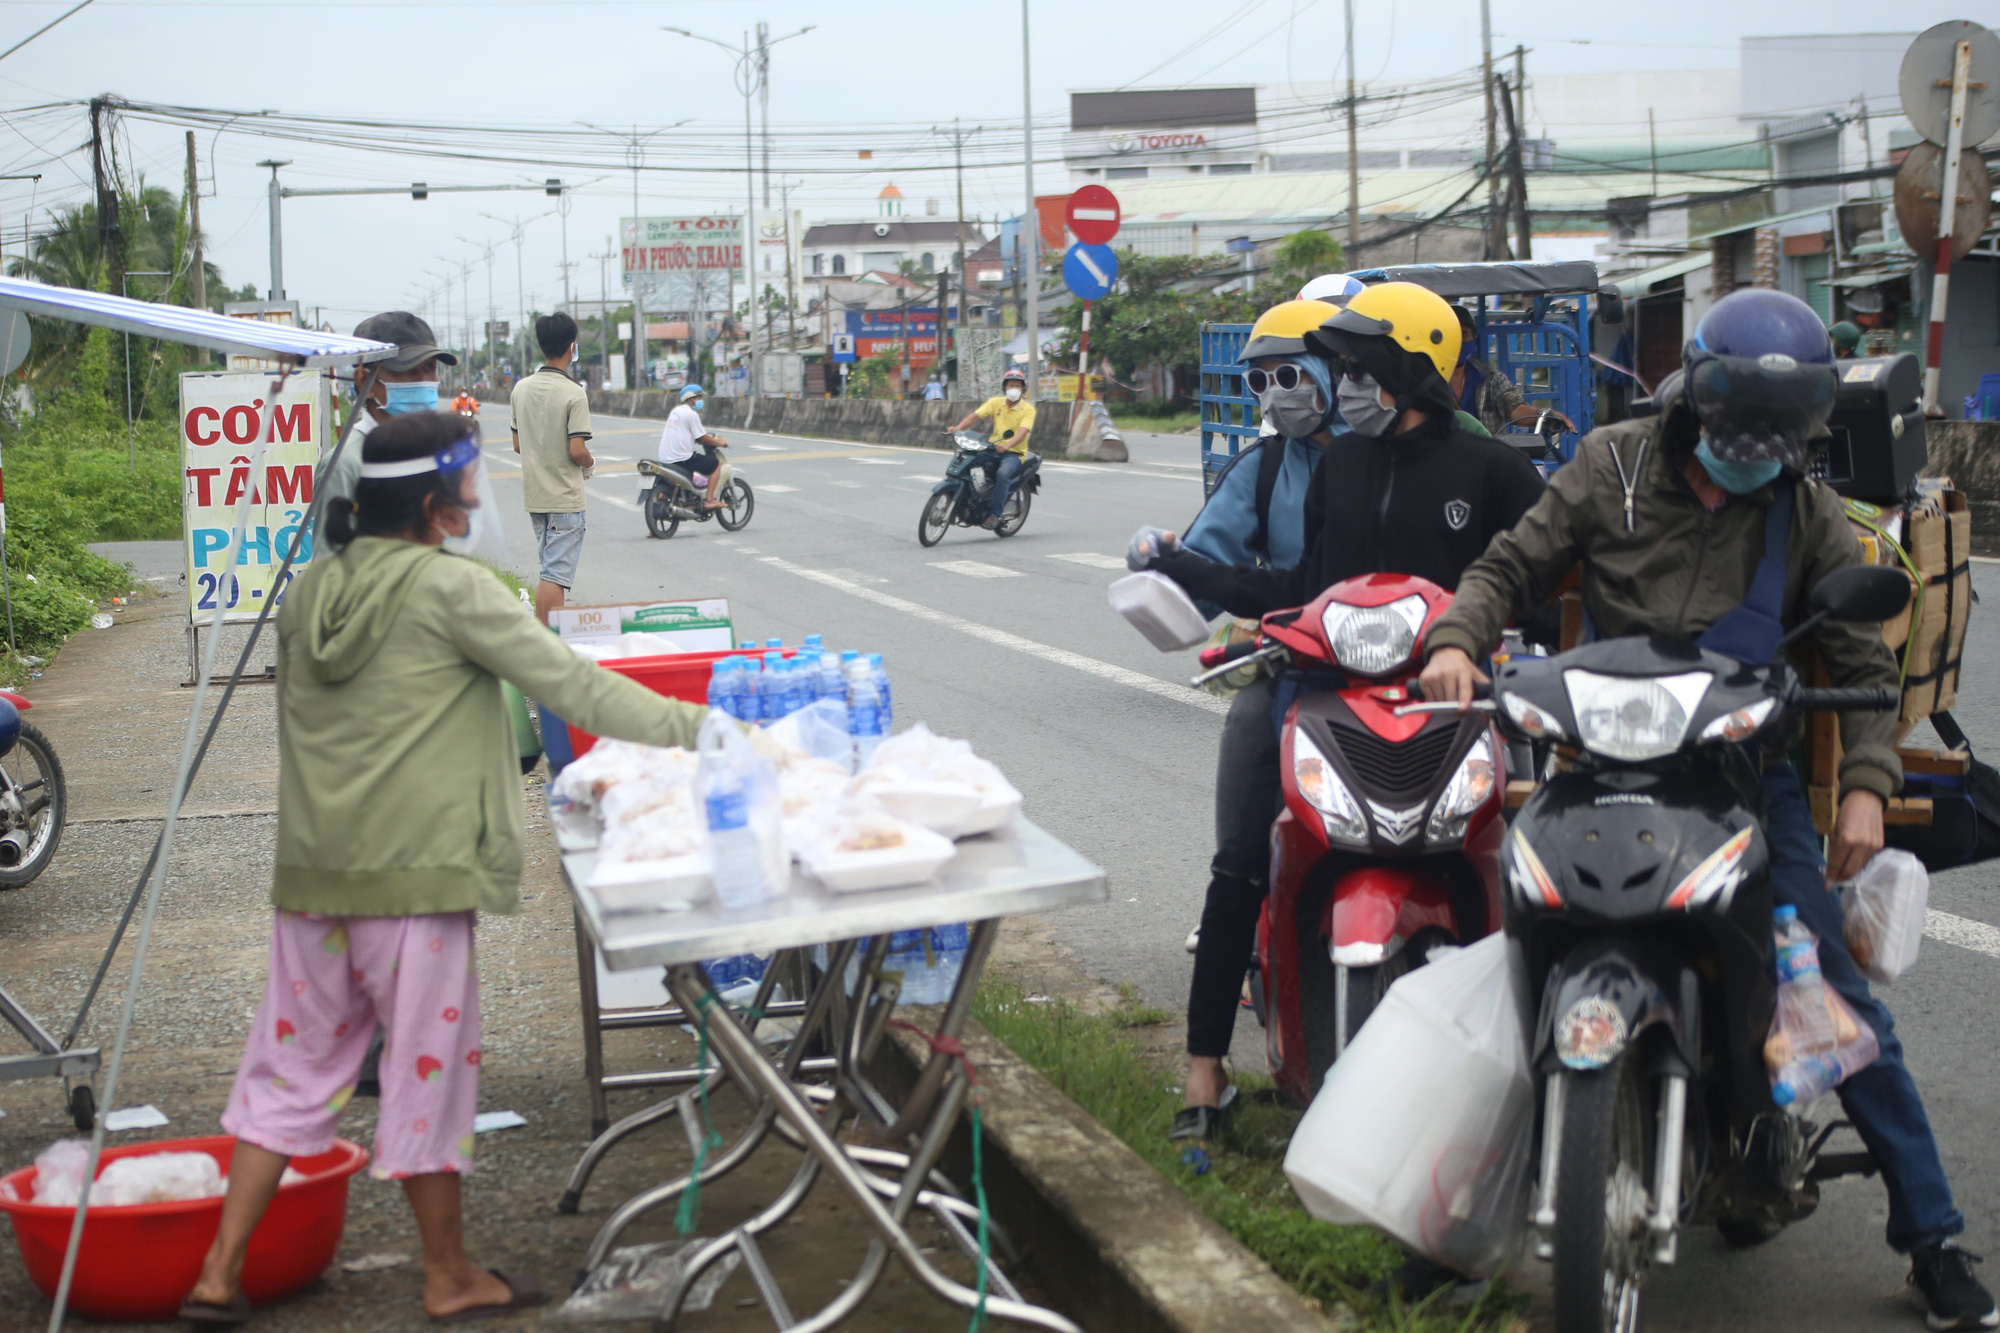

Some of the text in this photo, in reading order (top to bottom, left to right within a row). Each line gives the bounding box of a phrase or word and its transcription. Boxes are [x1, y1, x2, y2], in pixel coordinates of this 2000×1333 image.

[1137, 134, 1207, 149] TOYOTA
[184, 398, 311, 446] CƠM
[192, 509, 314, 568] PHỞ
[197, 572, 239, 610] 20
[578, 611, 603, 626] 100
